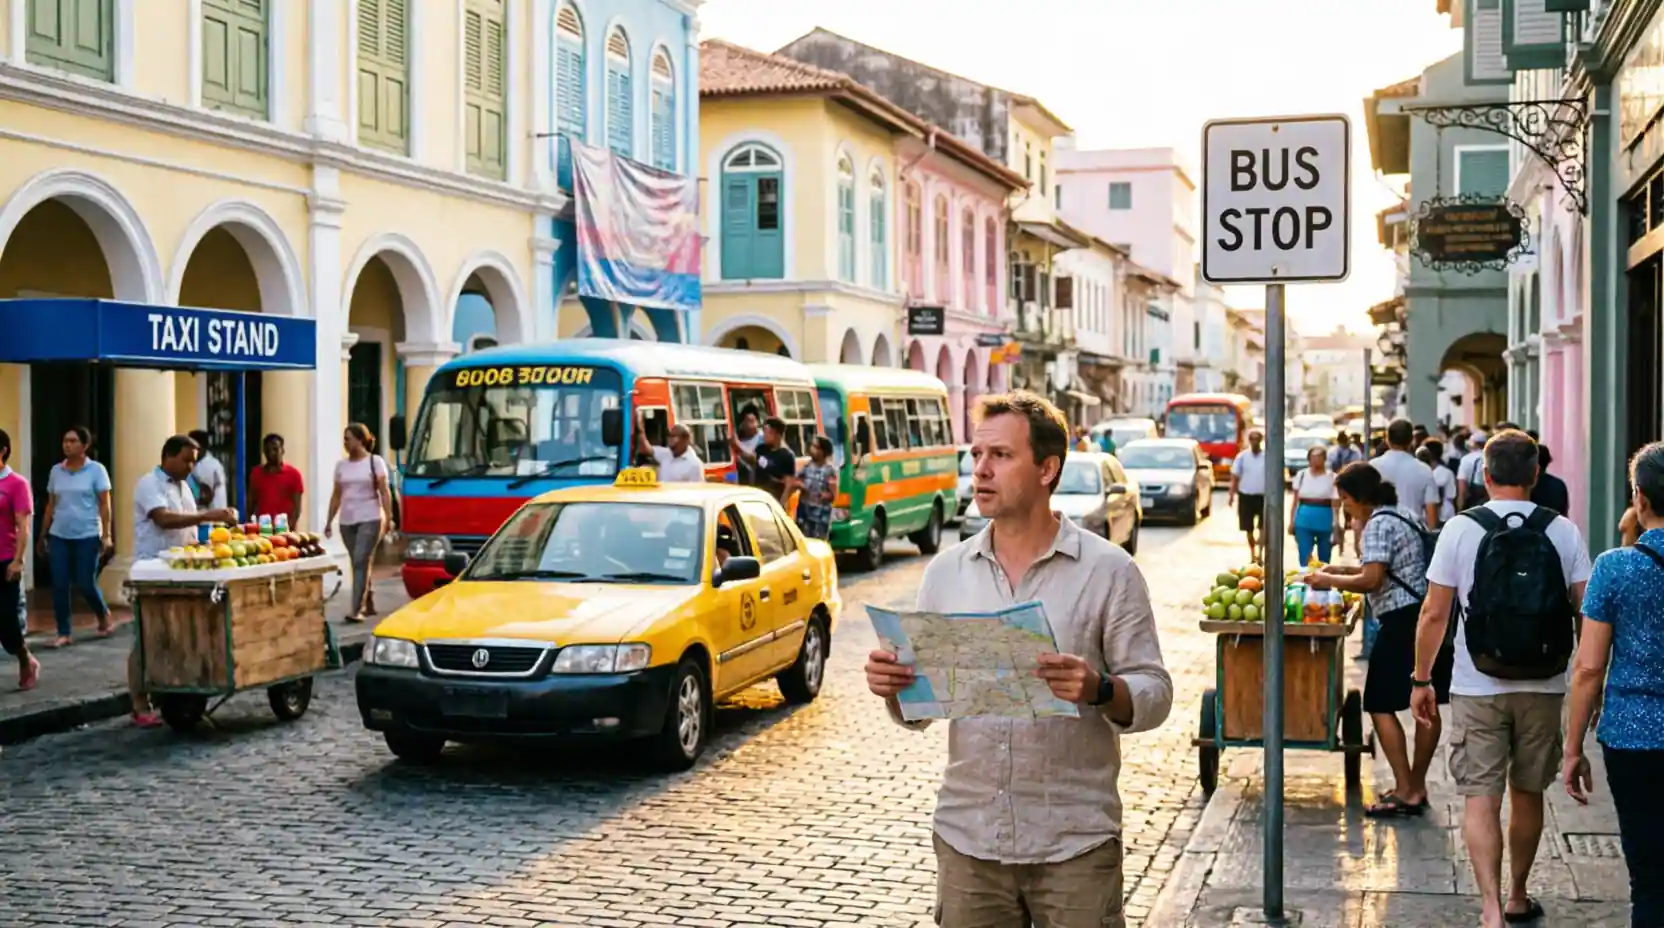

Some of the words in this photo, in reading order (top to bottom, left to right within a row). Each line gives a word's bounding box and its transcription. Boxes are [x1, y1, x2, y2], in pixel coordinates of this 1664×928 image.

[1230, 146, 1320, 192] BUS
[1217, 206, 1333, 252] STOP
[148, 313, 200, 352] TAXI
[207, 318, 279, 357] STAND
